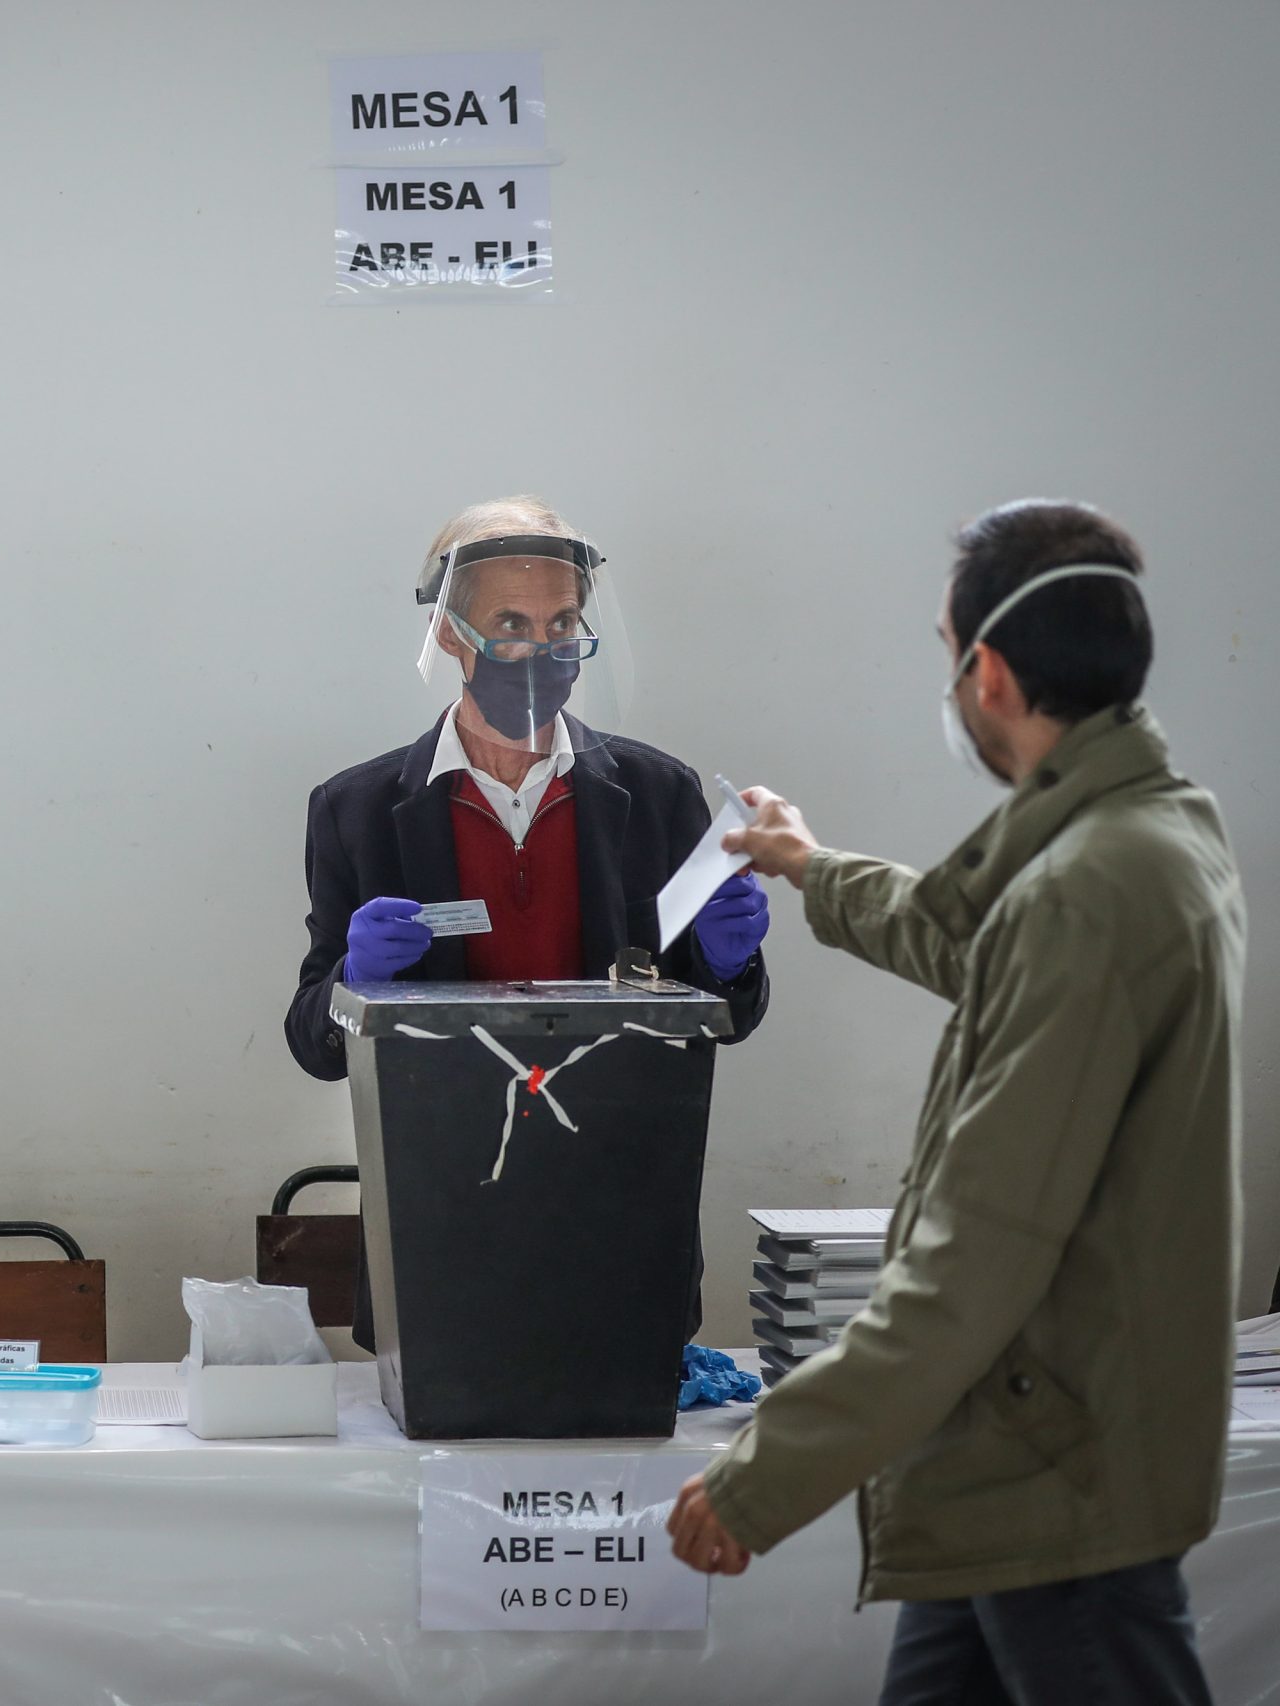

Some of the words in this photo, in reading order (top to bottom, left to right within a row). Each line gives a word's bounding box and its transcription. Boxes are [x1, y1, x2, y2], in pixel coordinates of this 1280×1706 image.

[351, 90, 488, 129] MESA
[498, 85, 519, 125] 1
[366, 181, 484, 211] MESA
[498, 181, 516, 210] 1
[349, 242, 433, 271] ABE
[475, 241, 538, 270] ELI
[502, 1491, 599, 1518] MESA
[611, 1490, 624, 1517] 1
[483, 1537, 554, 1563] ABE
[594, 1536, 645, 1562] ELI
